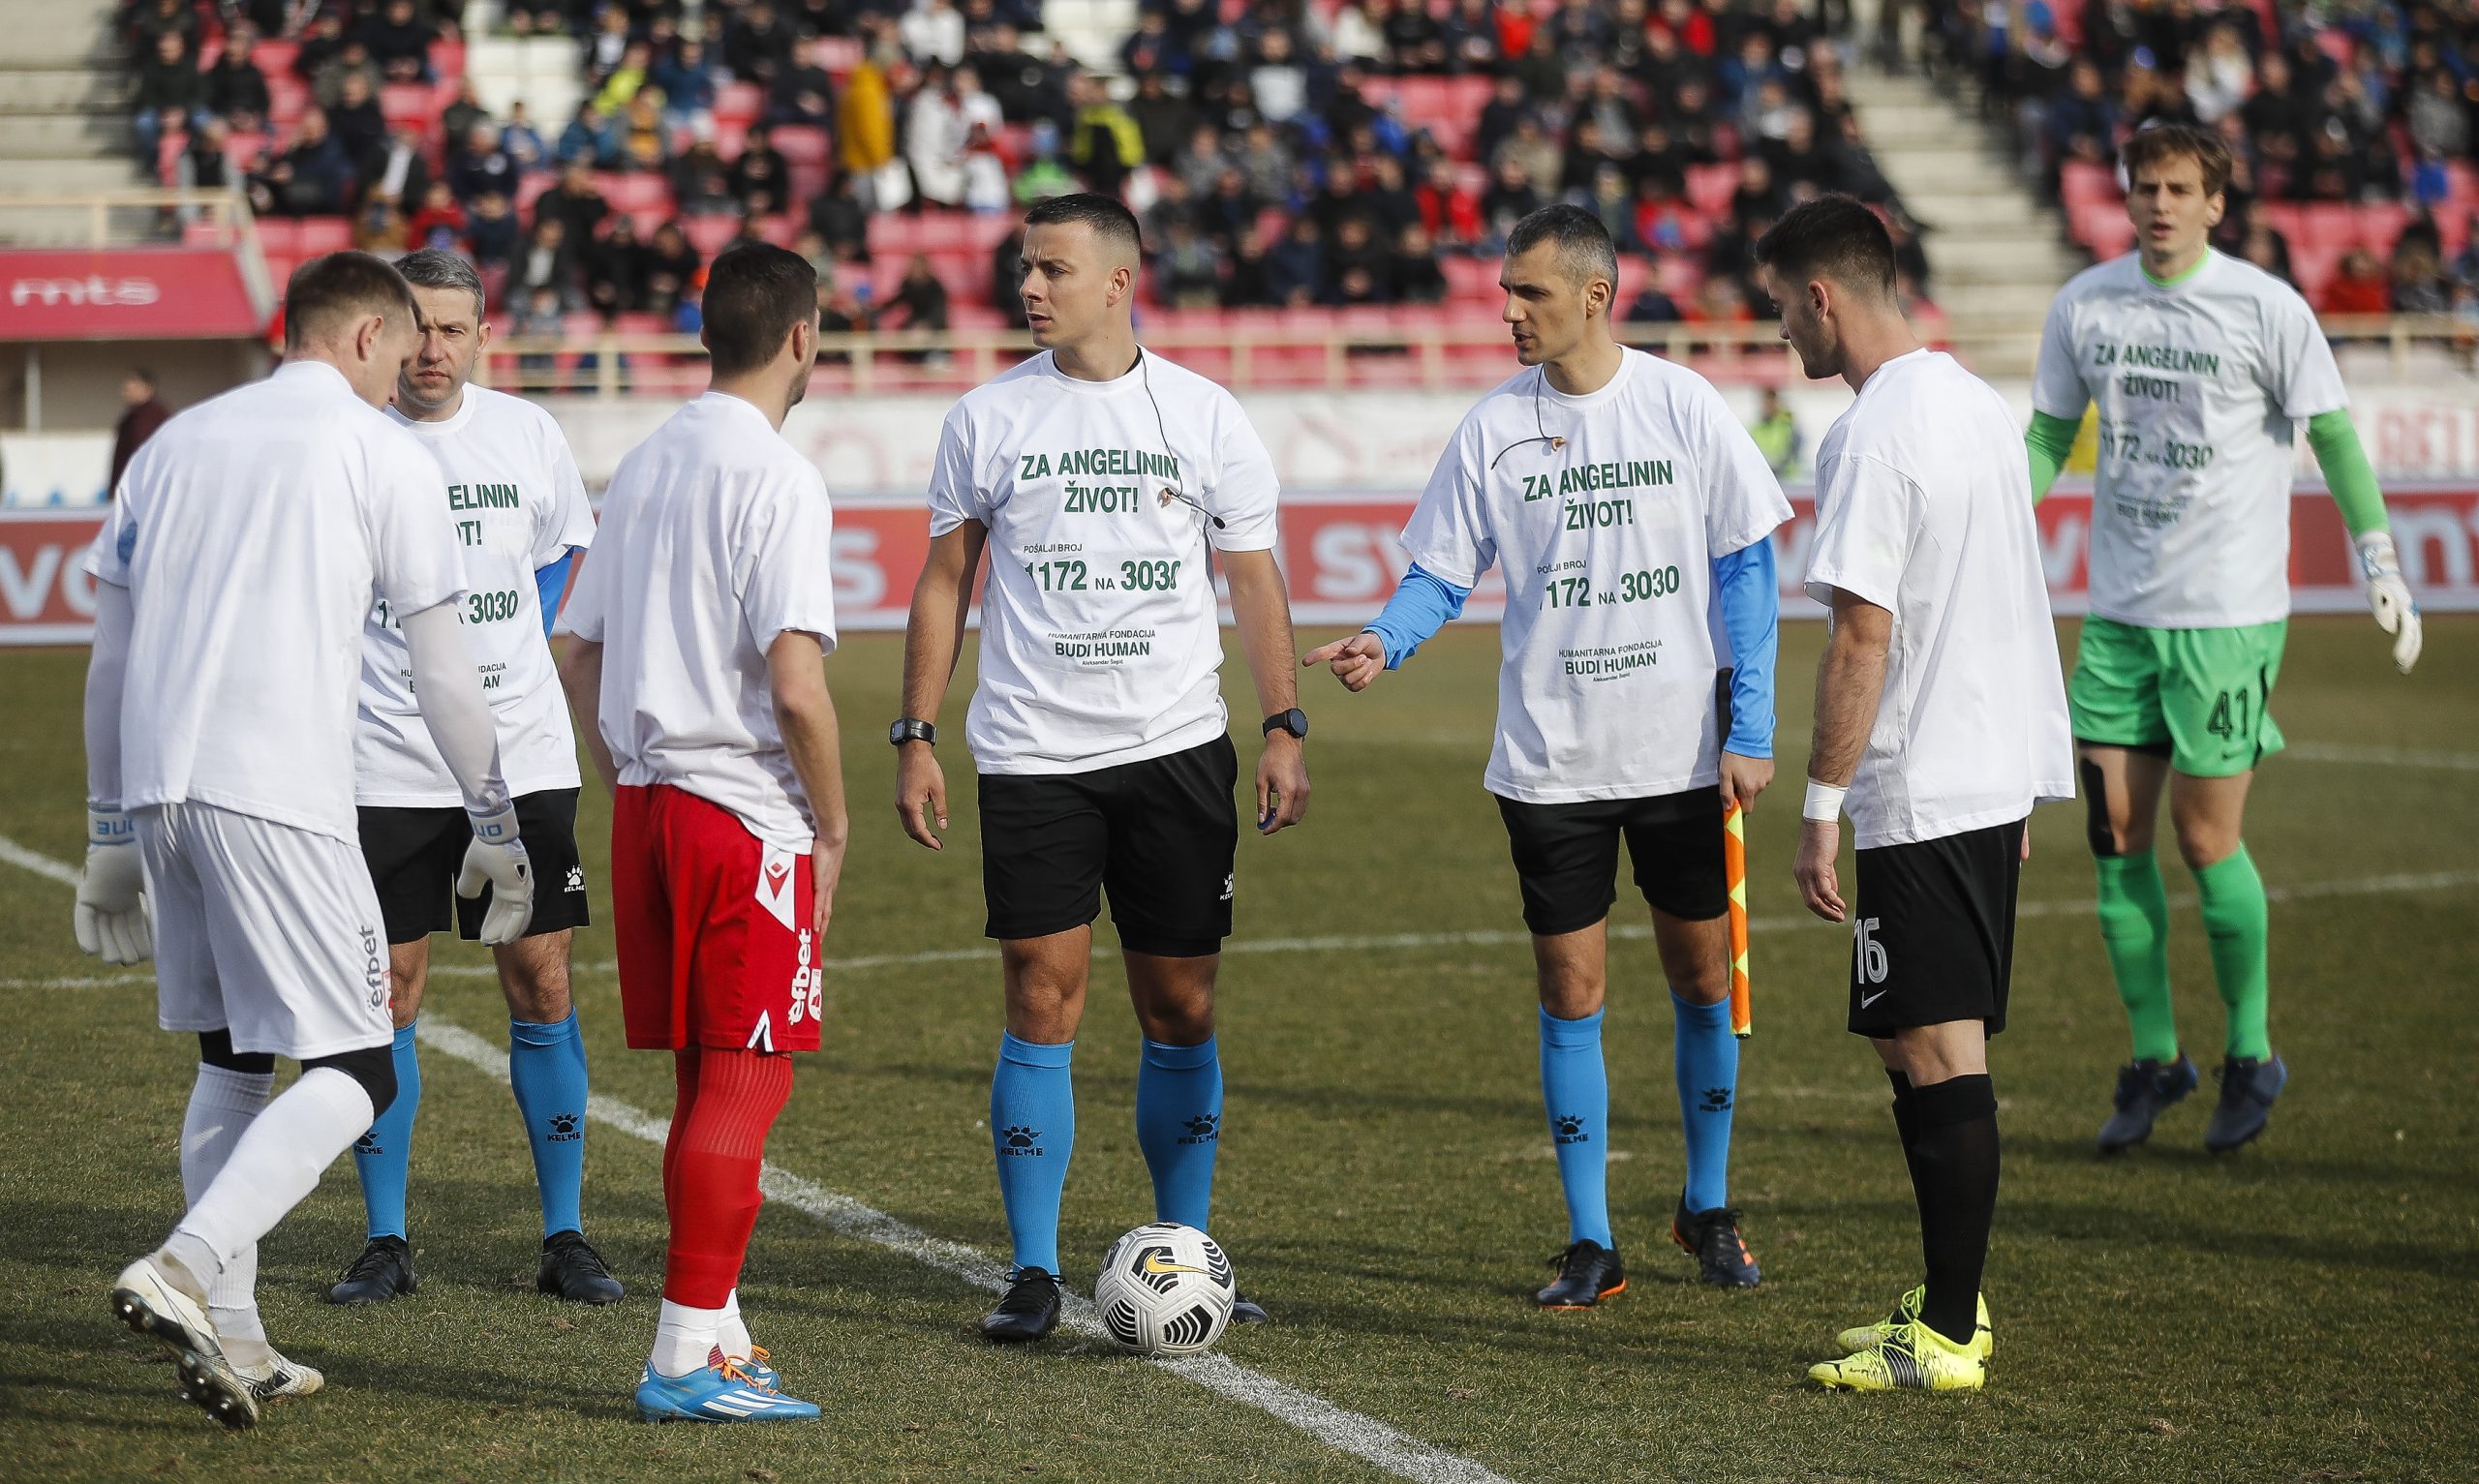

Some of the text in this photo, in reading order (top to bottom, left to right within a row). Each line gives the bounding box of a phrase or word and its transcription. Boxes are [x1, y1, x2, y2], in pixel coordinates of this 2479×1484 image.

[2095, 344, 2115, 365] ZA
[1021, 449, 1178, 481] ZA ANGELININ
[1522, 460, 1673, 501] ZA ANGELININ
[448, 484, 519, 510] ELININ
[1064, 480, 1138, 513] ŽIVOT!
[1565, 499, 1633, 530] ŽIVOT!
[1024, 543, 1083, 554] POŠALJI BROJ
[1563, 560, 1587, 570] BROJ
[1095, 578, 1116, 590] NA
[1540, 565, 1680, 611] 172 NA 3030
[469, 590, 518, 623] 3030
[1048, 629, 1156, 641] HUMANITARNA FONDACIJA
[1055, 642, 1149, 657] BUDI HUMAN
[1558, 639, 1663, 658] HUMANITARNA FONDACIJA
[478, 662, 506, 674] DACIJA
[1565, 651, 1657, 675] BUDI HUMAN
[2207, 685, 2248, 742] 41
[565, 884, 585, 893] KELME
[1853, 917, 1888, 984] 16
[359, 924, 383, 1011] efbet
[788, 927, 811, 1026] efbet
[547, 1131, 581, 1142] KELME
[1555, 1134, 1589, 1144] KELME
[1000, 1147, 1044, 1157] KELME
